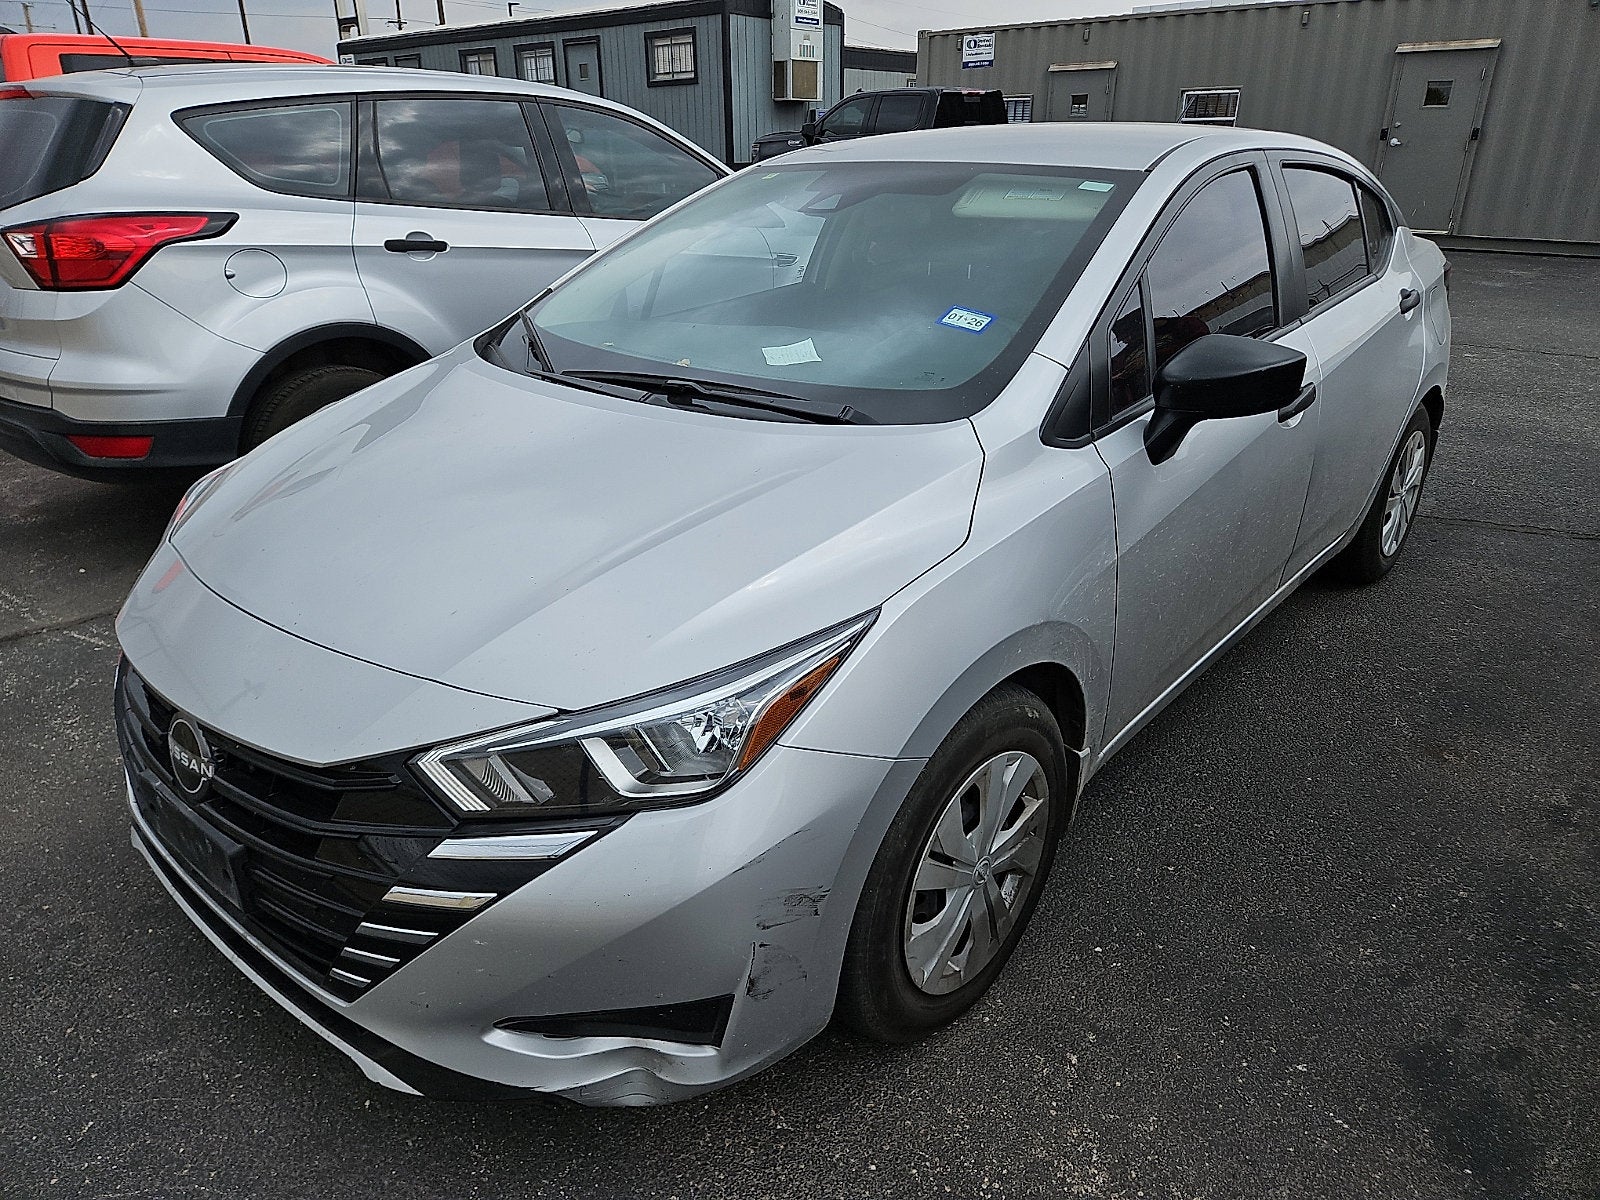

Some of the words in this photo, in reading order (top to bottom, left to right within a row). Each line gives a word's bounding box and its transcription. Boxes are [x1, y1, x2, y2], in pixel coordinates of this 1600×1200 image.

[947, 312, 964, 322] 01
[966, 317, 985, 327] 26
[171, 744, 214, 778] SSAN
